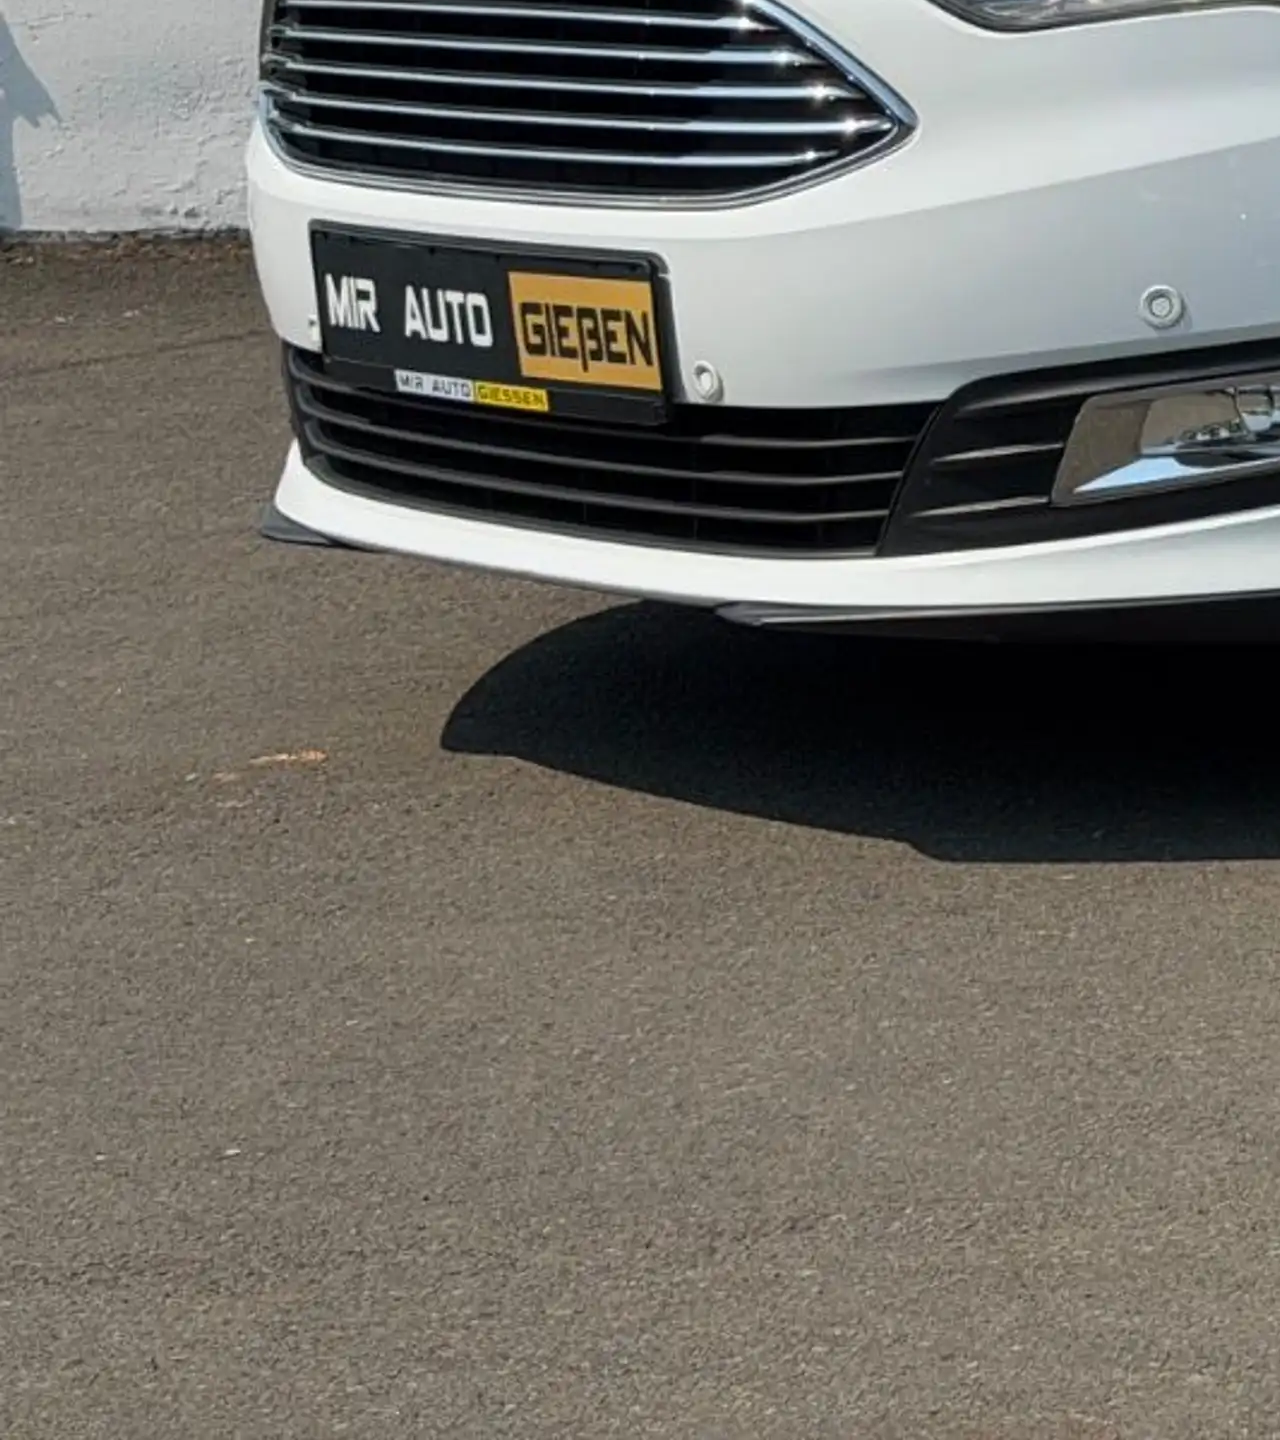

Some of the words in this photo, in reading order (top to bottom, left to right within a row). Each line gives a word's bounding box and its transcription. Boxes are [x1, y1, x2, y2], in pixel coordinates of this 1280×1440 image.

[325, 273, 381, 333] MIR
[404, 285, 493, 348] AUTO
[400, 373, 424, 389] MIR
[432, 378, 471, 398] AUTO
